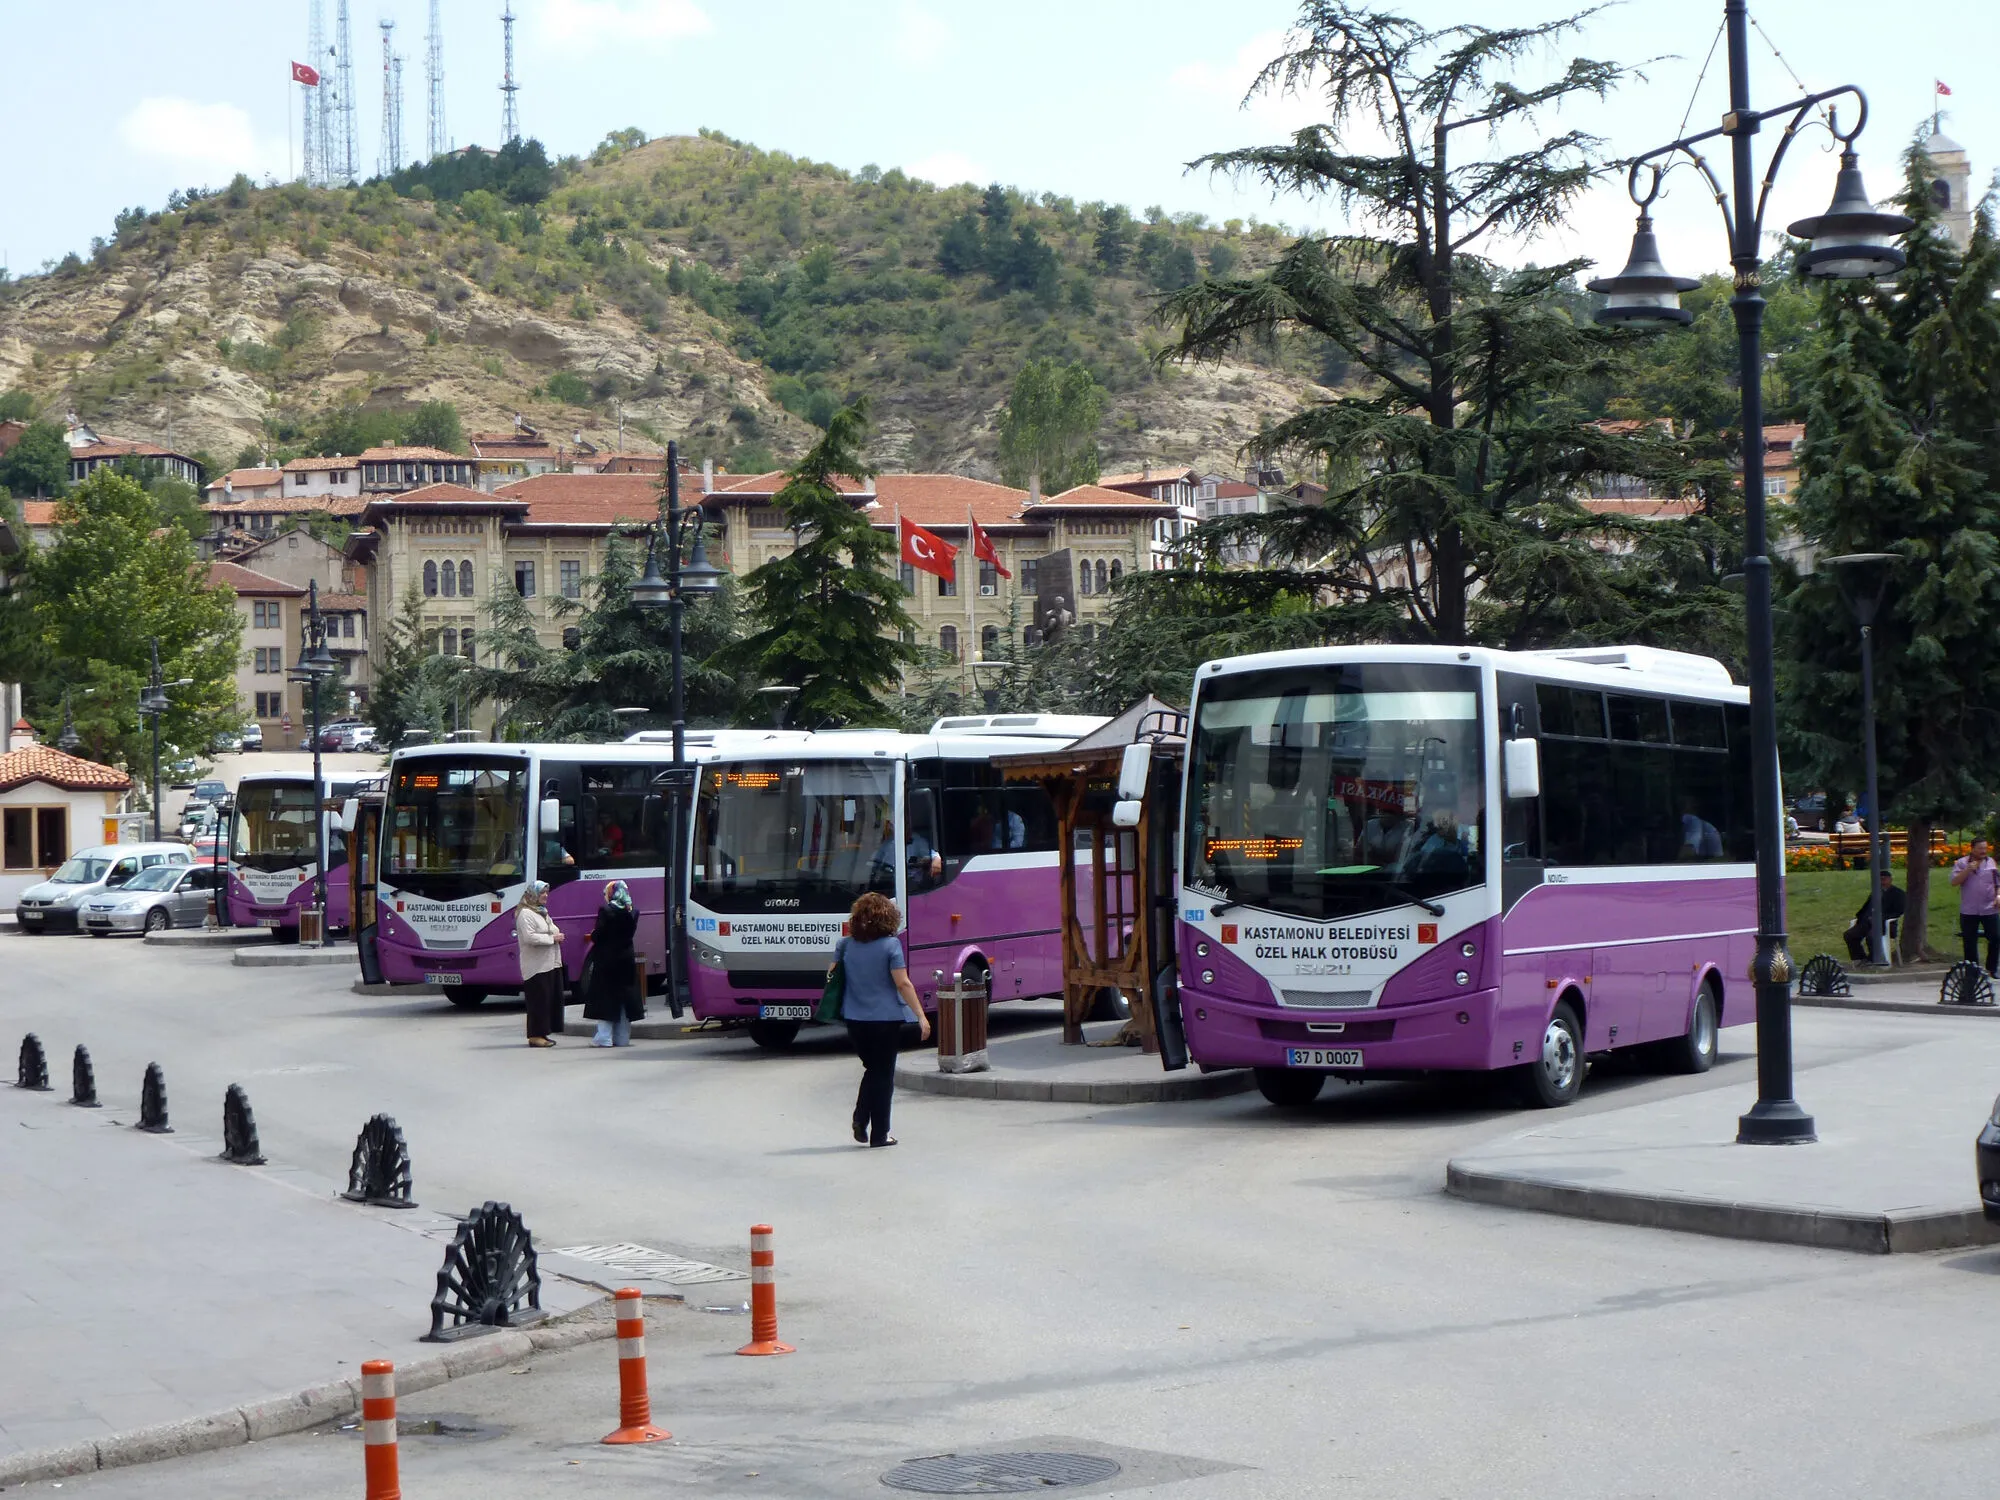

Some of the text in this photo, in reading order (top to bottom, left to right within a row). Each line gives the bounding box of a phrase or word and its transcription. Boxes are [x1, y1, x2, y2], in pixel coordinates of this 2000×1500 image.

[406, 902, 488, 912] KASTAMONU BELEDİYESİ
[764, 898, 801, 907] OTOKAR
[412, 914, 482, 923] ÖZEL HALK OTOBÜSÜ
[732, 921, 841, 933] KASTAMONU BELEDİYESİ
[1244, 924, 1411, 940] KASTAMONU BELEDİYESİ
[741, 935, 830, 945] ÖZEL HALK OTOBÜSÜ
[1255, 944, 1398, 960] ÖZEL HALK OTOBÜSÜ
[438, 975, 443, 983] D
[764, 1006, 810, 1017] 37 D 0003
[1294, 1050, 1359, 1065] 37 D 0007
